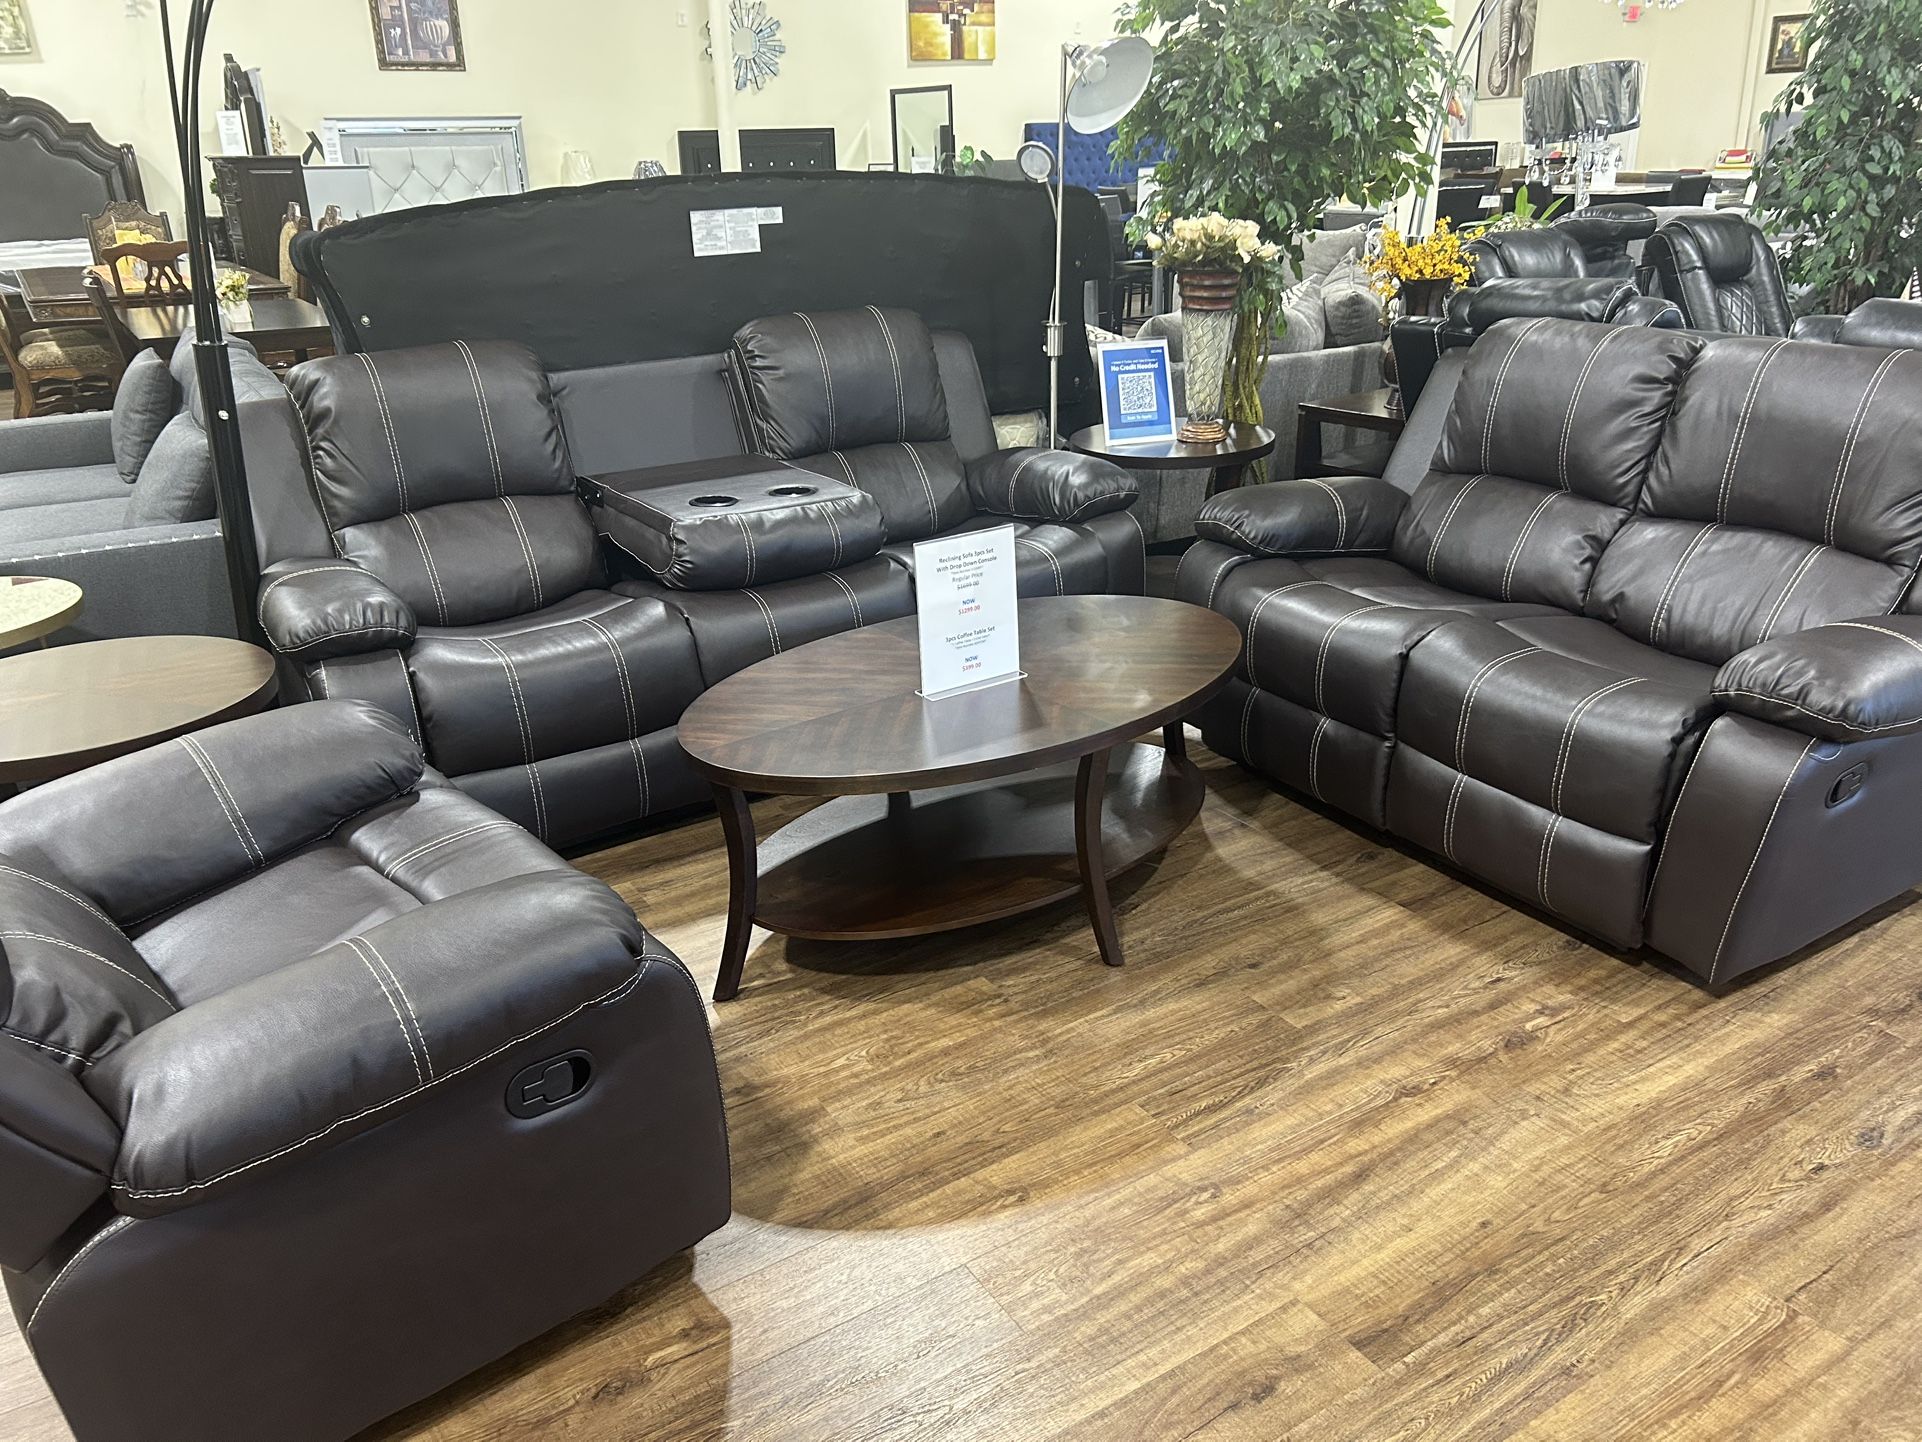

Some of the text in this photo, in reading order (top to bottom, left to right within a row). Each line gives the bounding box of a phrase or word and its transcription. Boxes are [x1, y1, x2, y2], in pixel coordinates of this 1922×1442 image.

[1137, 362, 1159, 370] Needed
[939, 555, 961, 563] Reclining
[978, 556, 997, 564] Console
[952, 574, 970, 582] Regular
[957, 632, 973, 640] Coffee
